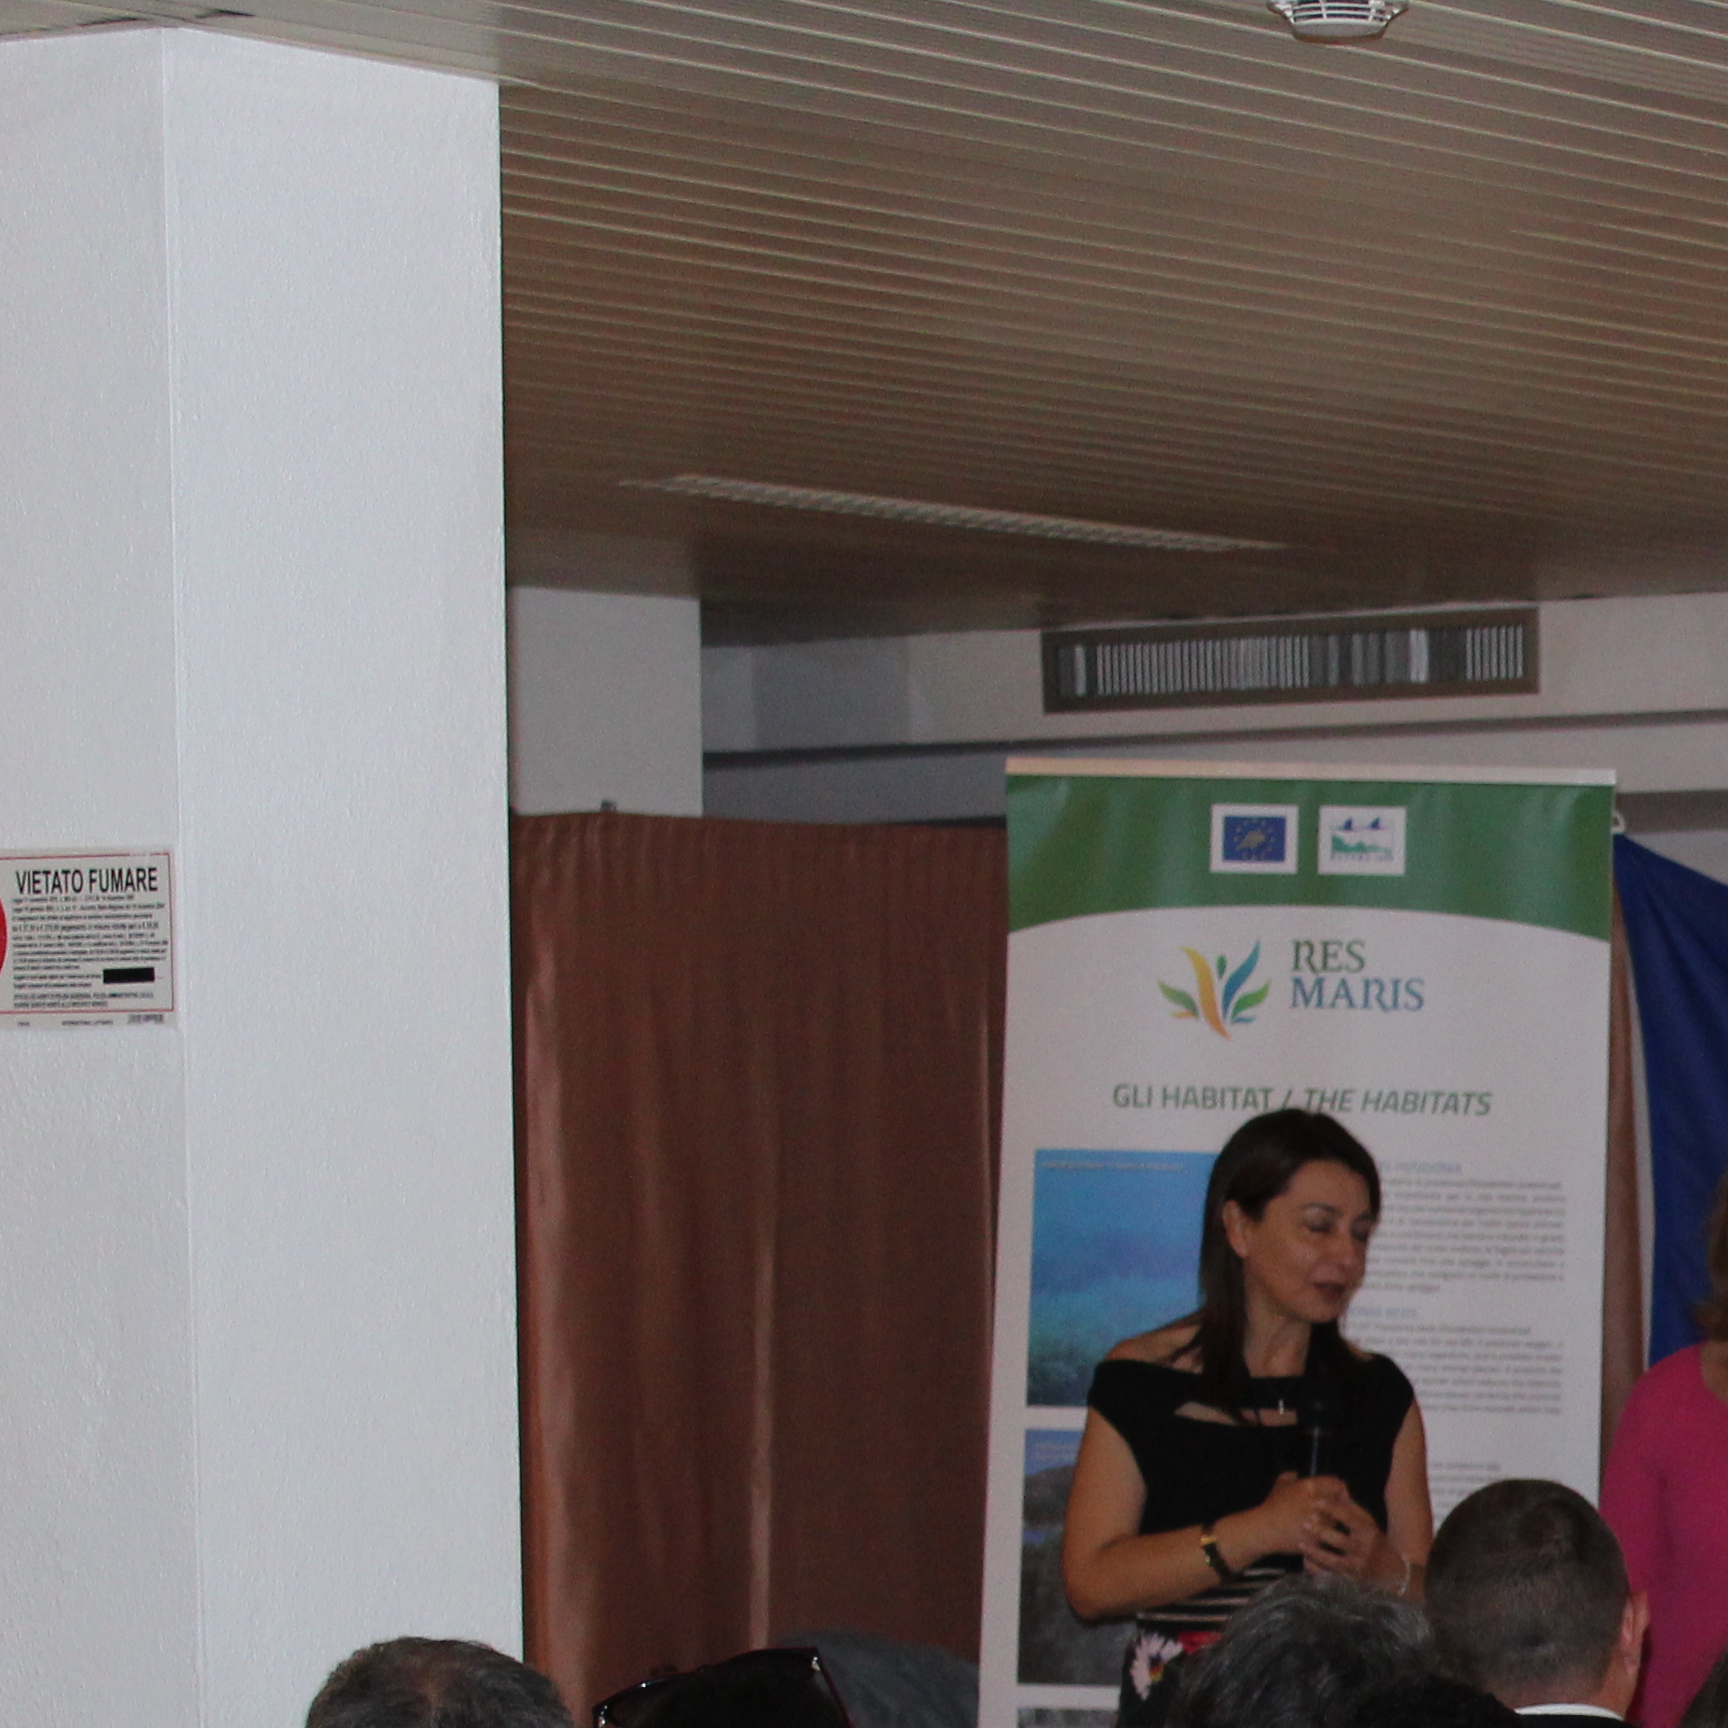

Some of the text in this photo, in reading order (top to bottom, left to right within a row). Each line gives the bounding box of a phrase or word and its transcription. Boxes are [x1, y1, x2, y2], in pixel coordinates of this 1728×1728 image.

[16, 866, 158, 895] VIETATO FUMARE
[1291, 938, 1367, 974] RES
[1290, 976, 1426, 1013] MARIS
[1112, 1083, 1153, 1109] GLI
[1161, 1084, 1274, 1111] HABITAT
[1304, 1087, 1357, 1114] THE
[1360, 1088, 1493, 1117] HABITATS
